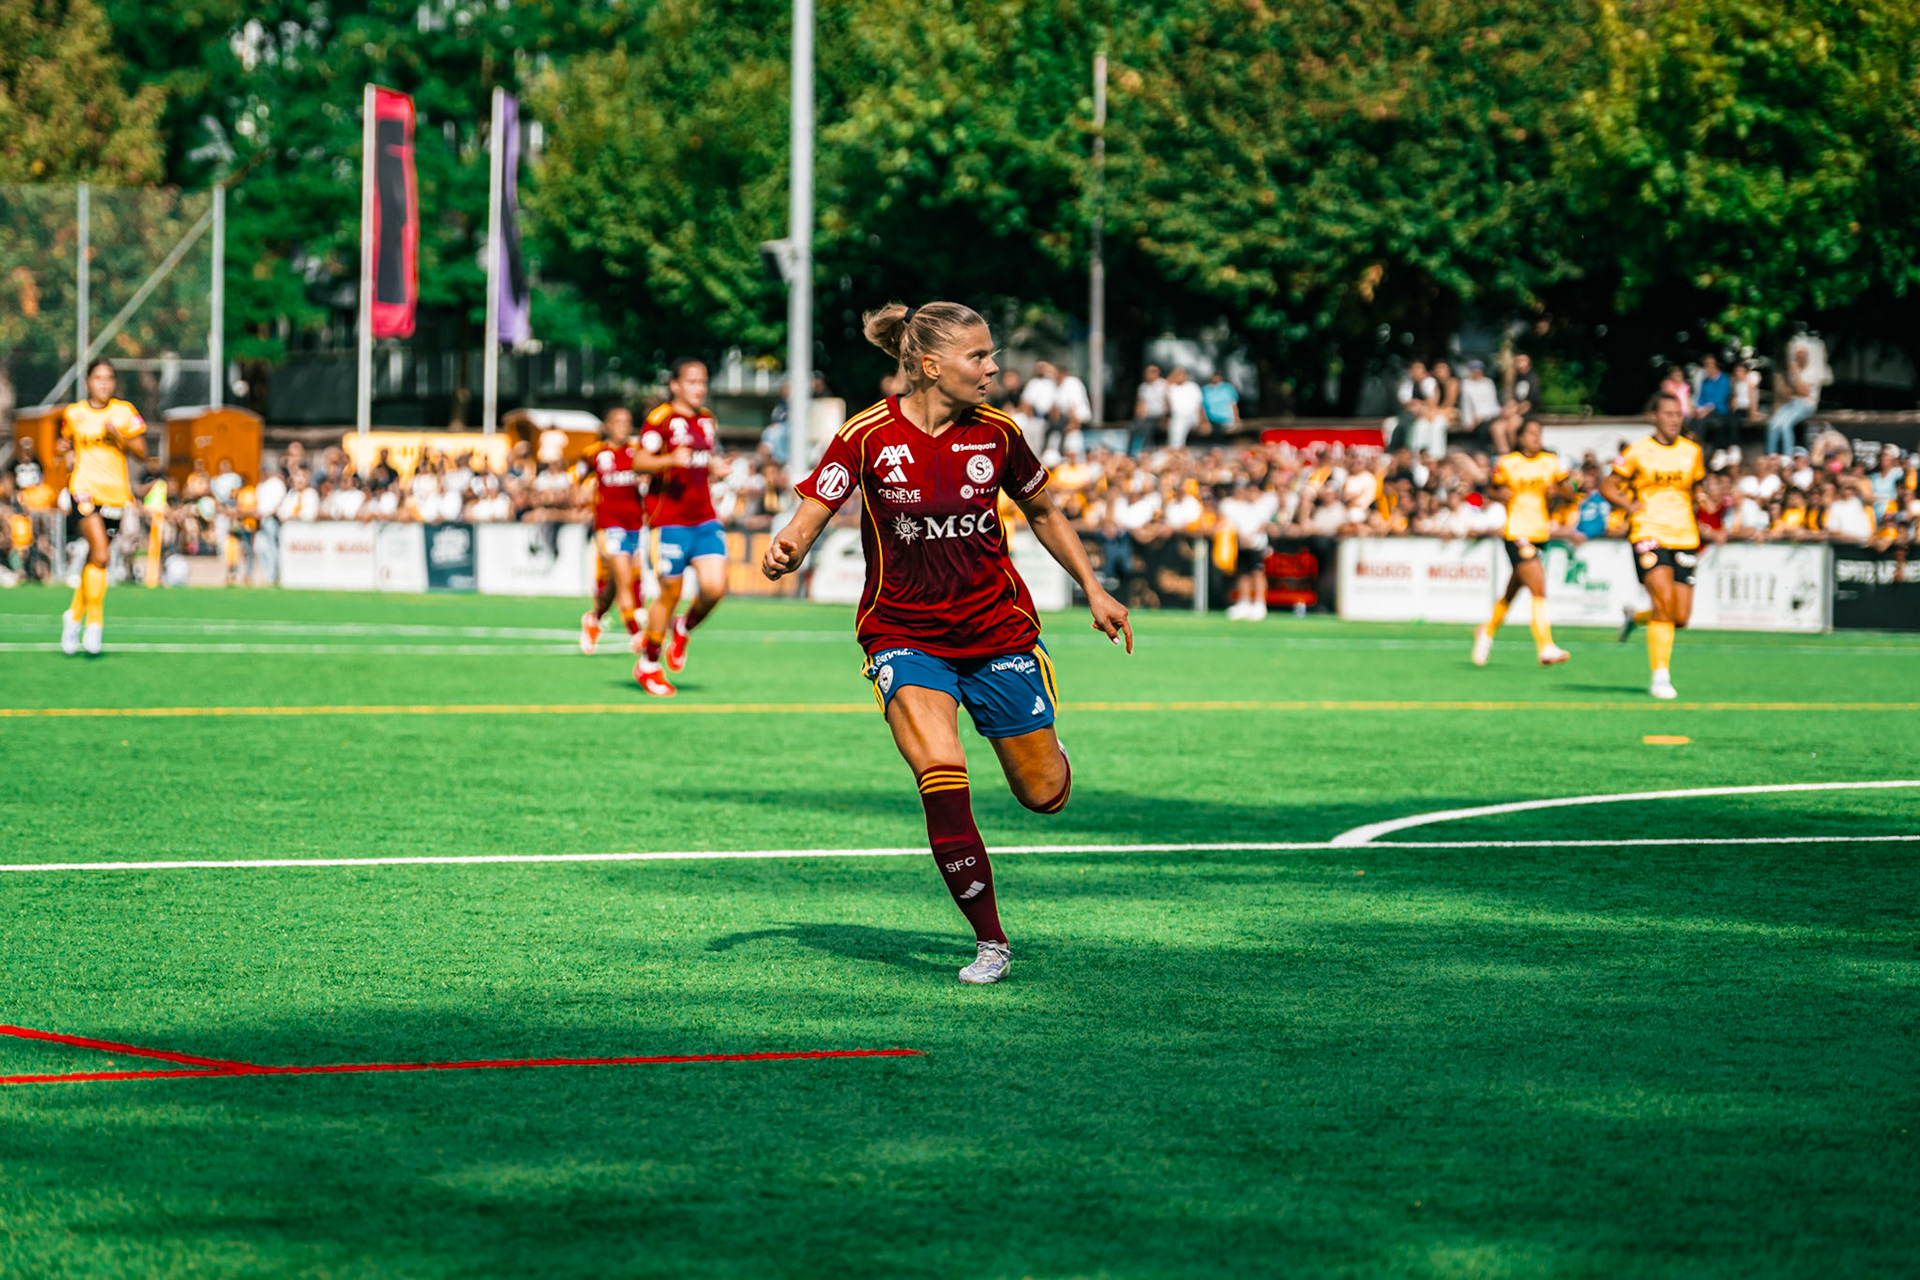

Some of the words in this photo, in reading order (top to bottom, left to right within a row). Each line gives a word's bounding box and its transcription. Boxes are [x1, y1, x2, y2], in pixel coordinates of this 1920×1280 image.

[873, 444, 915, 468] AXA
[819, 466, 847, 497] MG
[924, 508, 995, 540] MSC
[945, 856, 977, 873] SFC
